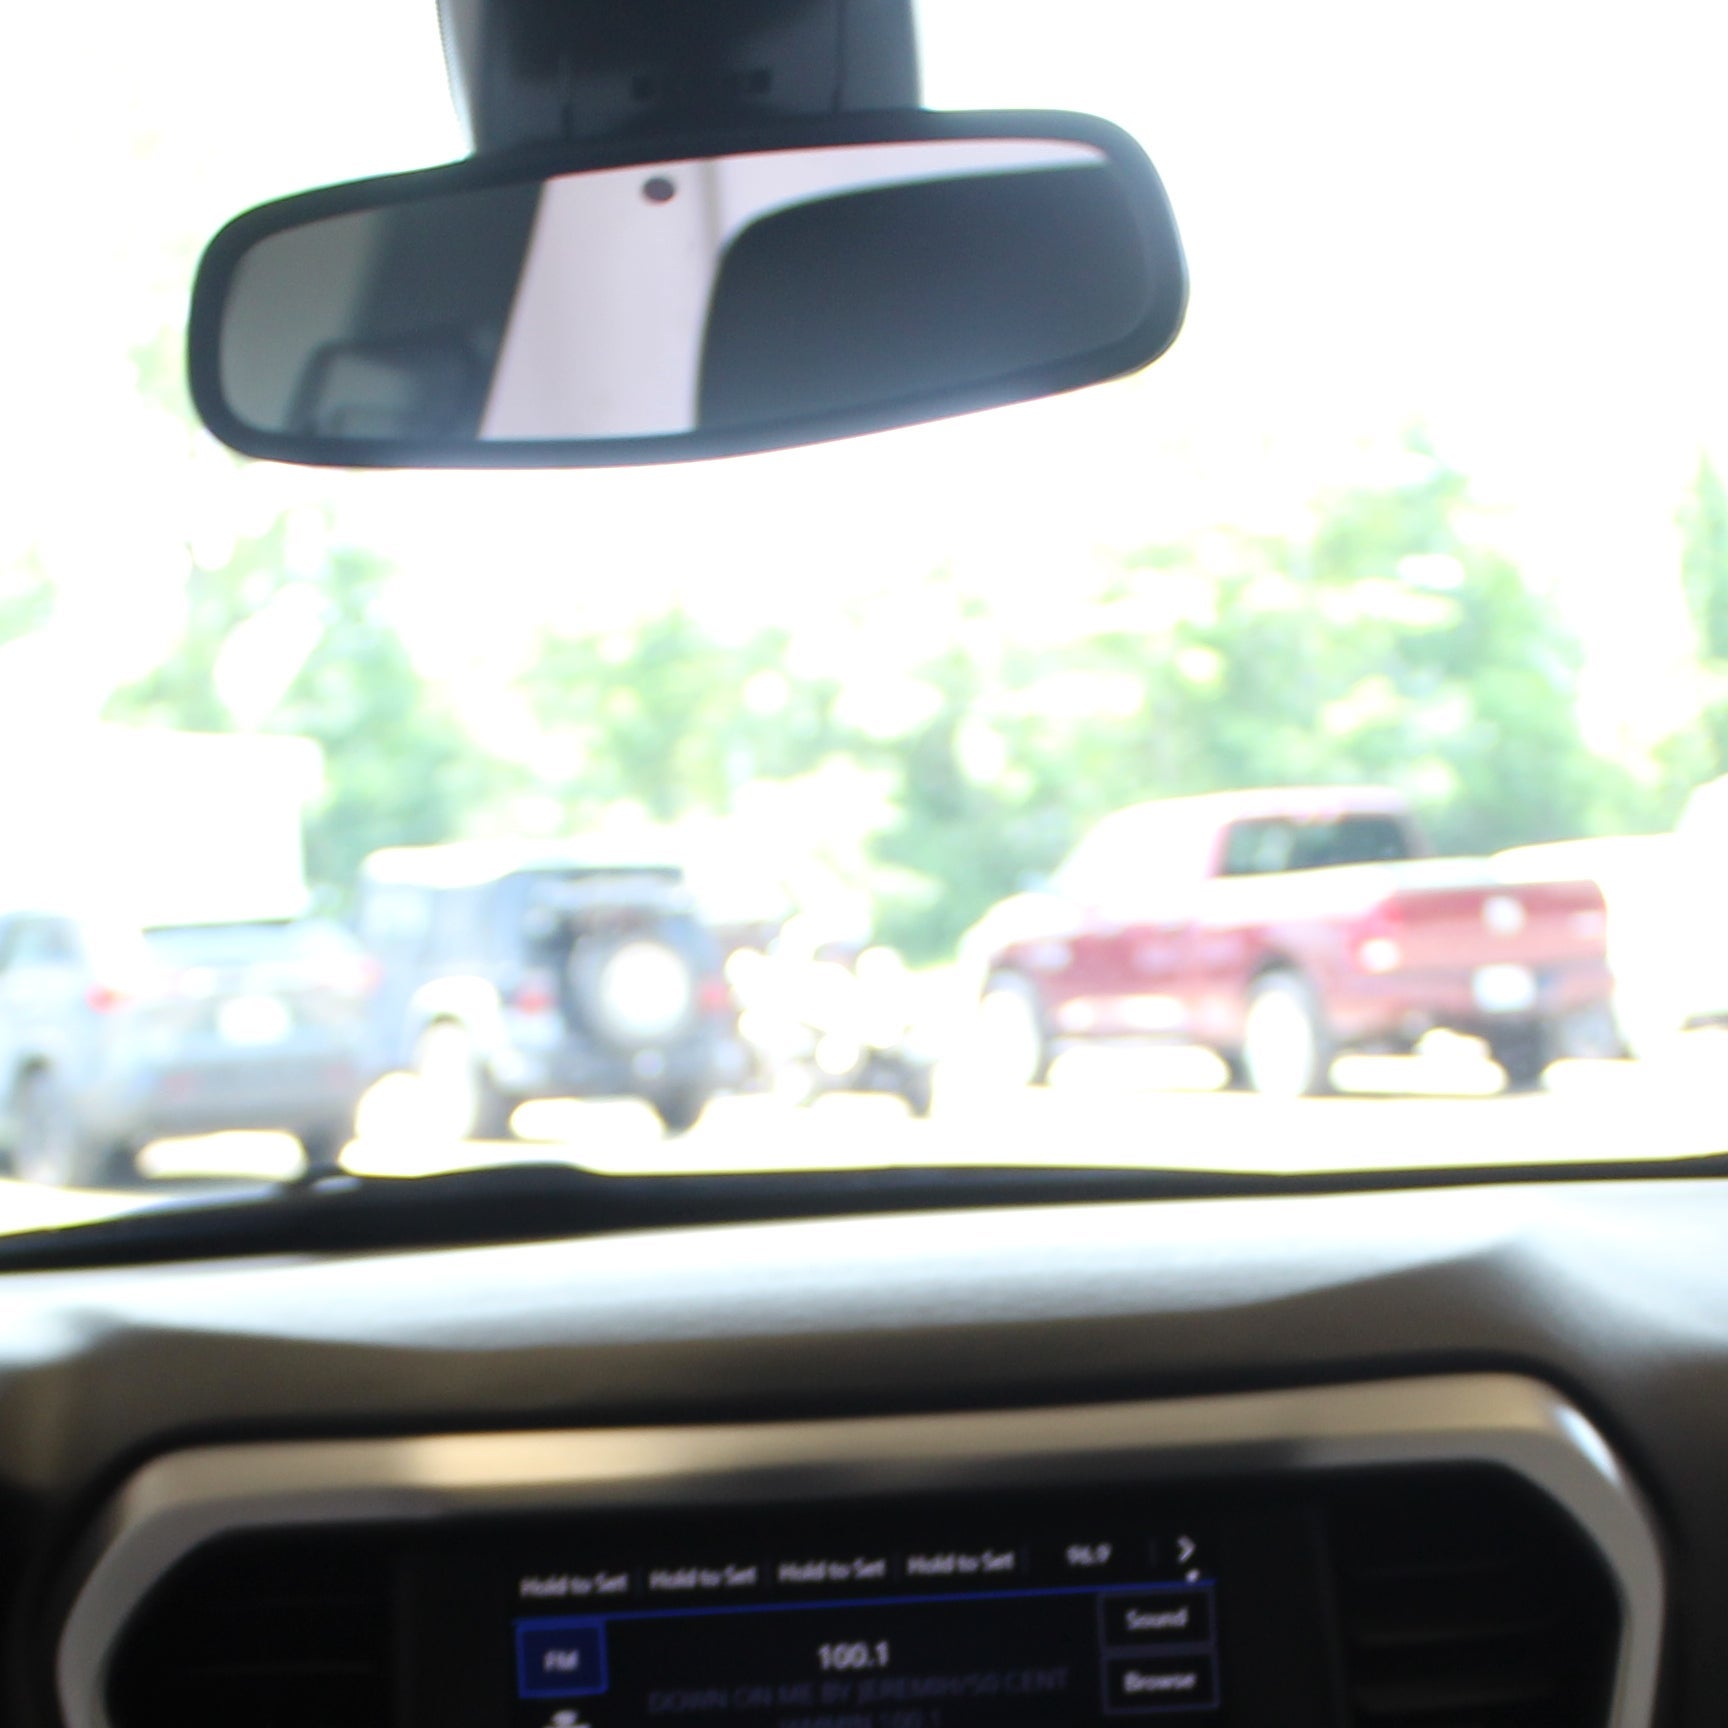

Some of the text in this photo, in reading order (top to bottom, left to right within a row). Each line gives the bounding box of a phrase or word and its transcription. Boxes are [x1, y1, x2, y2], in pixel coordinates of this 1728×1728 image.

[778, 1557, 886, 1583] Hold to Set
[906, 1549, 1015, 1576] Hold to Set
[520, 1571, 629, 1597] Hold to Set
[649, 1564, 758, 1590] Hold to Set
[1125, 1607, 1189, 1631] Sound
[544, 1650, 579, 1671] FM
[818, 1641, 890, 1670] 100.1
[1123, 1670, 1197, 1693] Browse
